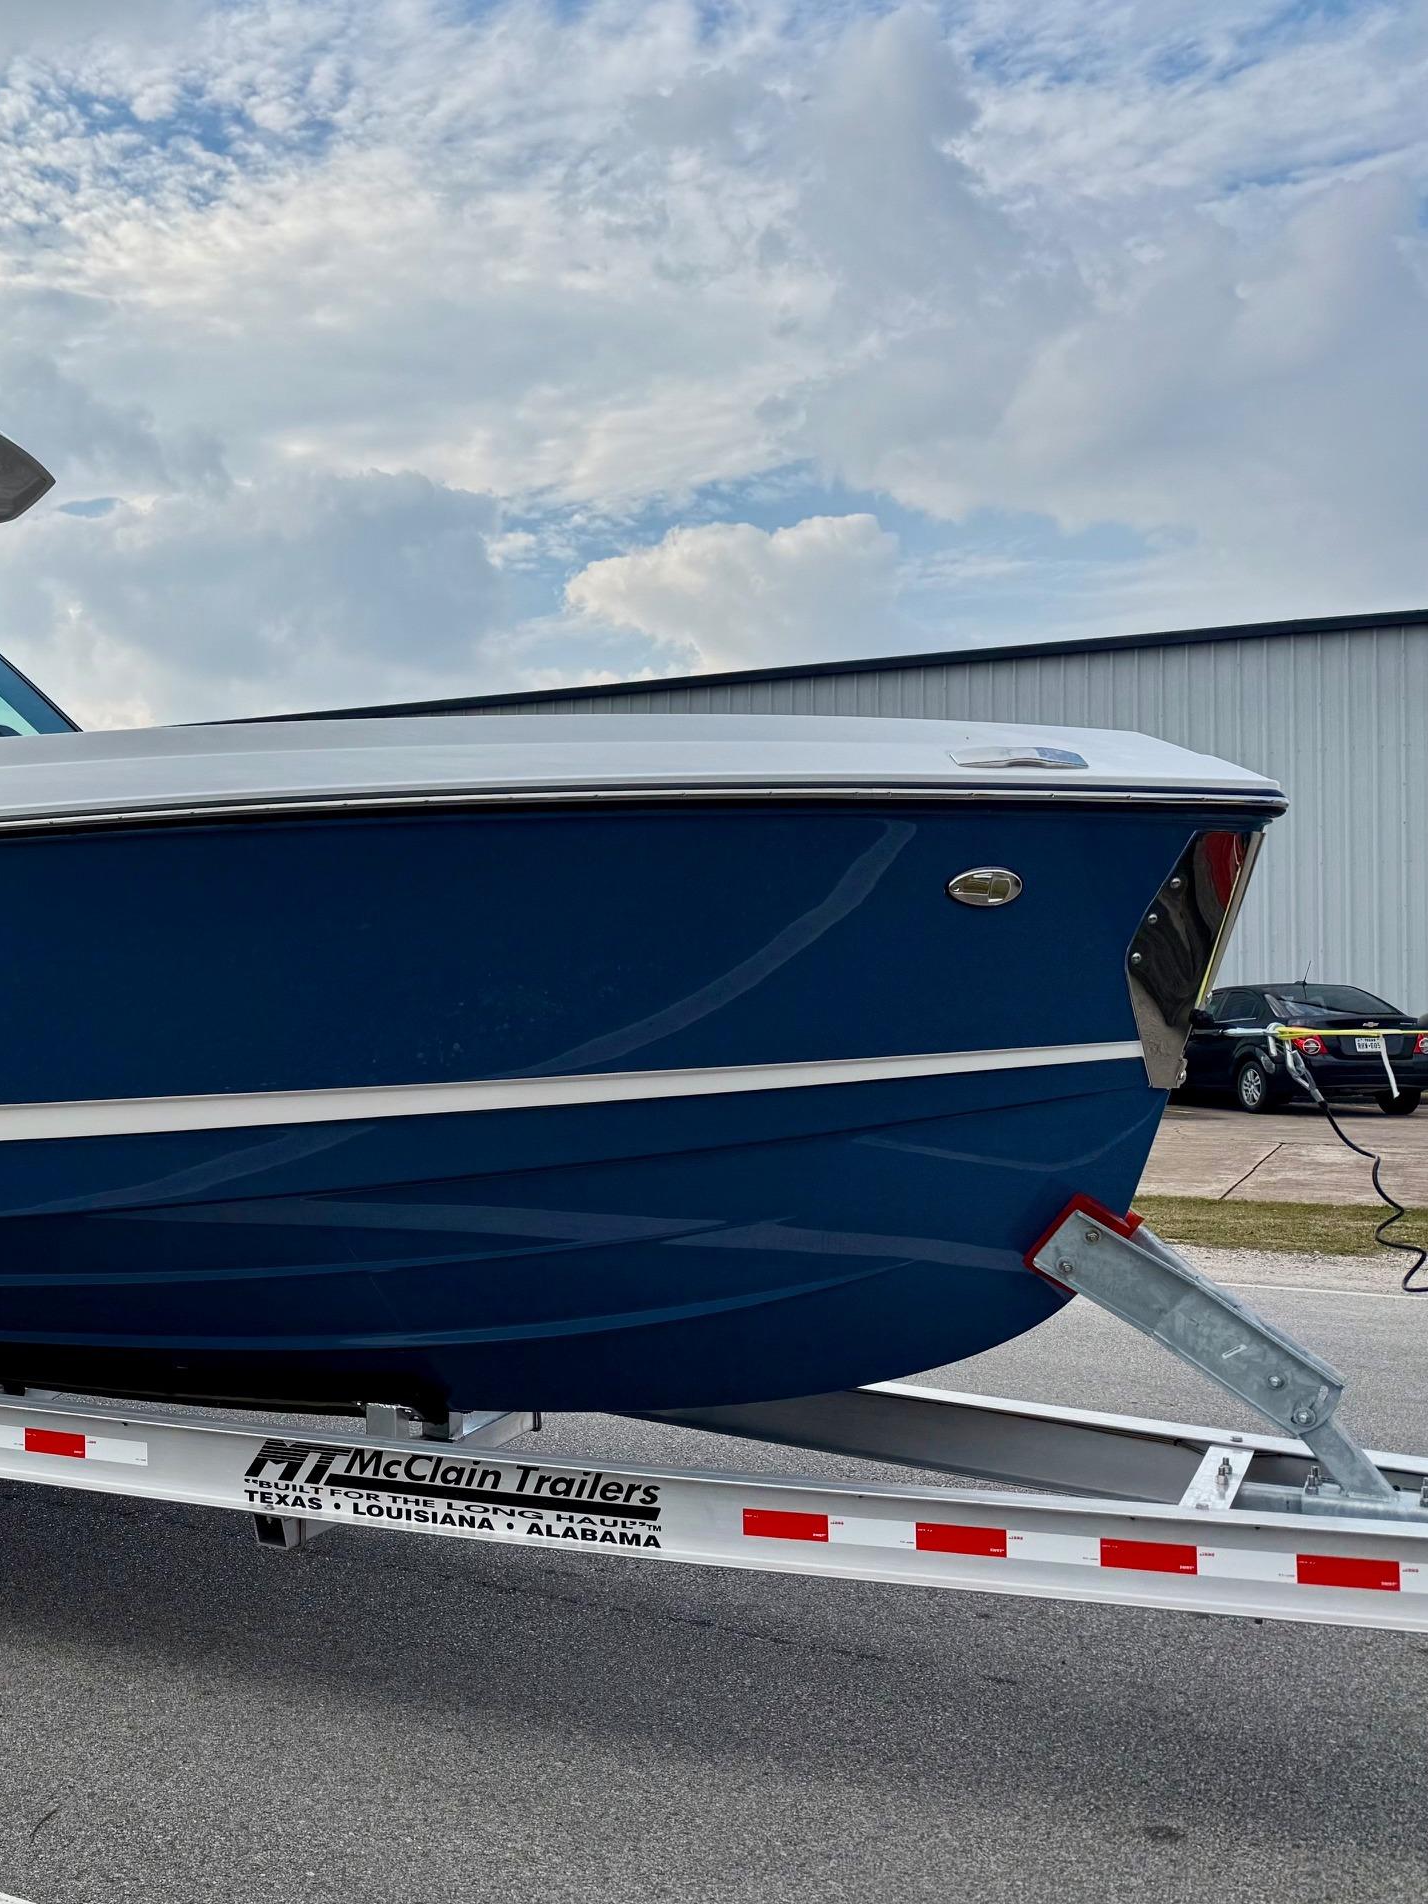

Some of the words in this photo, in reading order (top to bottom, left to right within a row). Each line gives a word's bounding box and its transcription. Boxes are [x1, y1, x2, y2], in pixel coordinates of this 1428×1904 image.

[330, 1488, 381, 1502] FOR
[388, 1495, 435, 1508] THE
[446, 1501, 544, 1520] LONG
[343, 1448, 502, 1490] McClain
[515, 1465, 661, 1505] Trailers
[244, 1489, 323, 1510] TEXAS
[352, 1502, 495, 1531] LOUISIANA
[526, 1522, 662, 1549] ALABAMA
